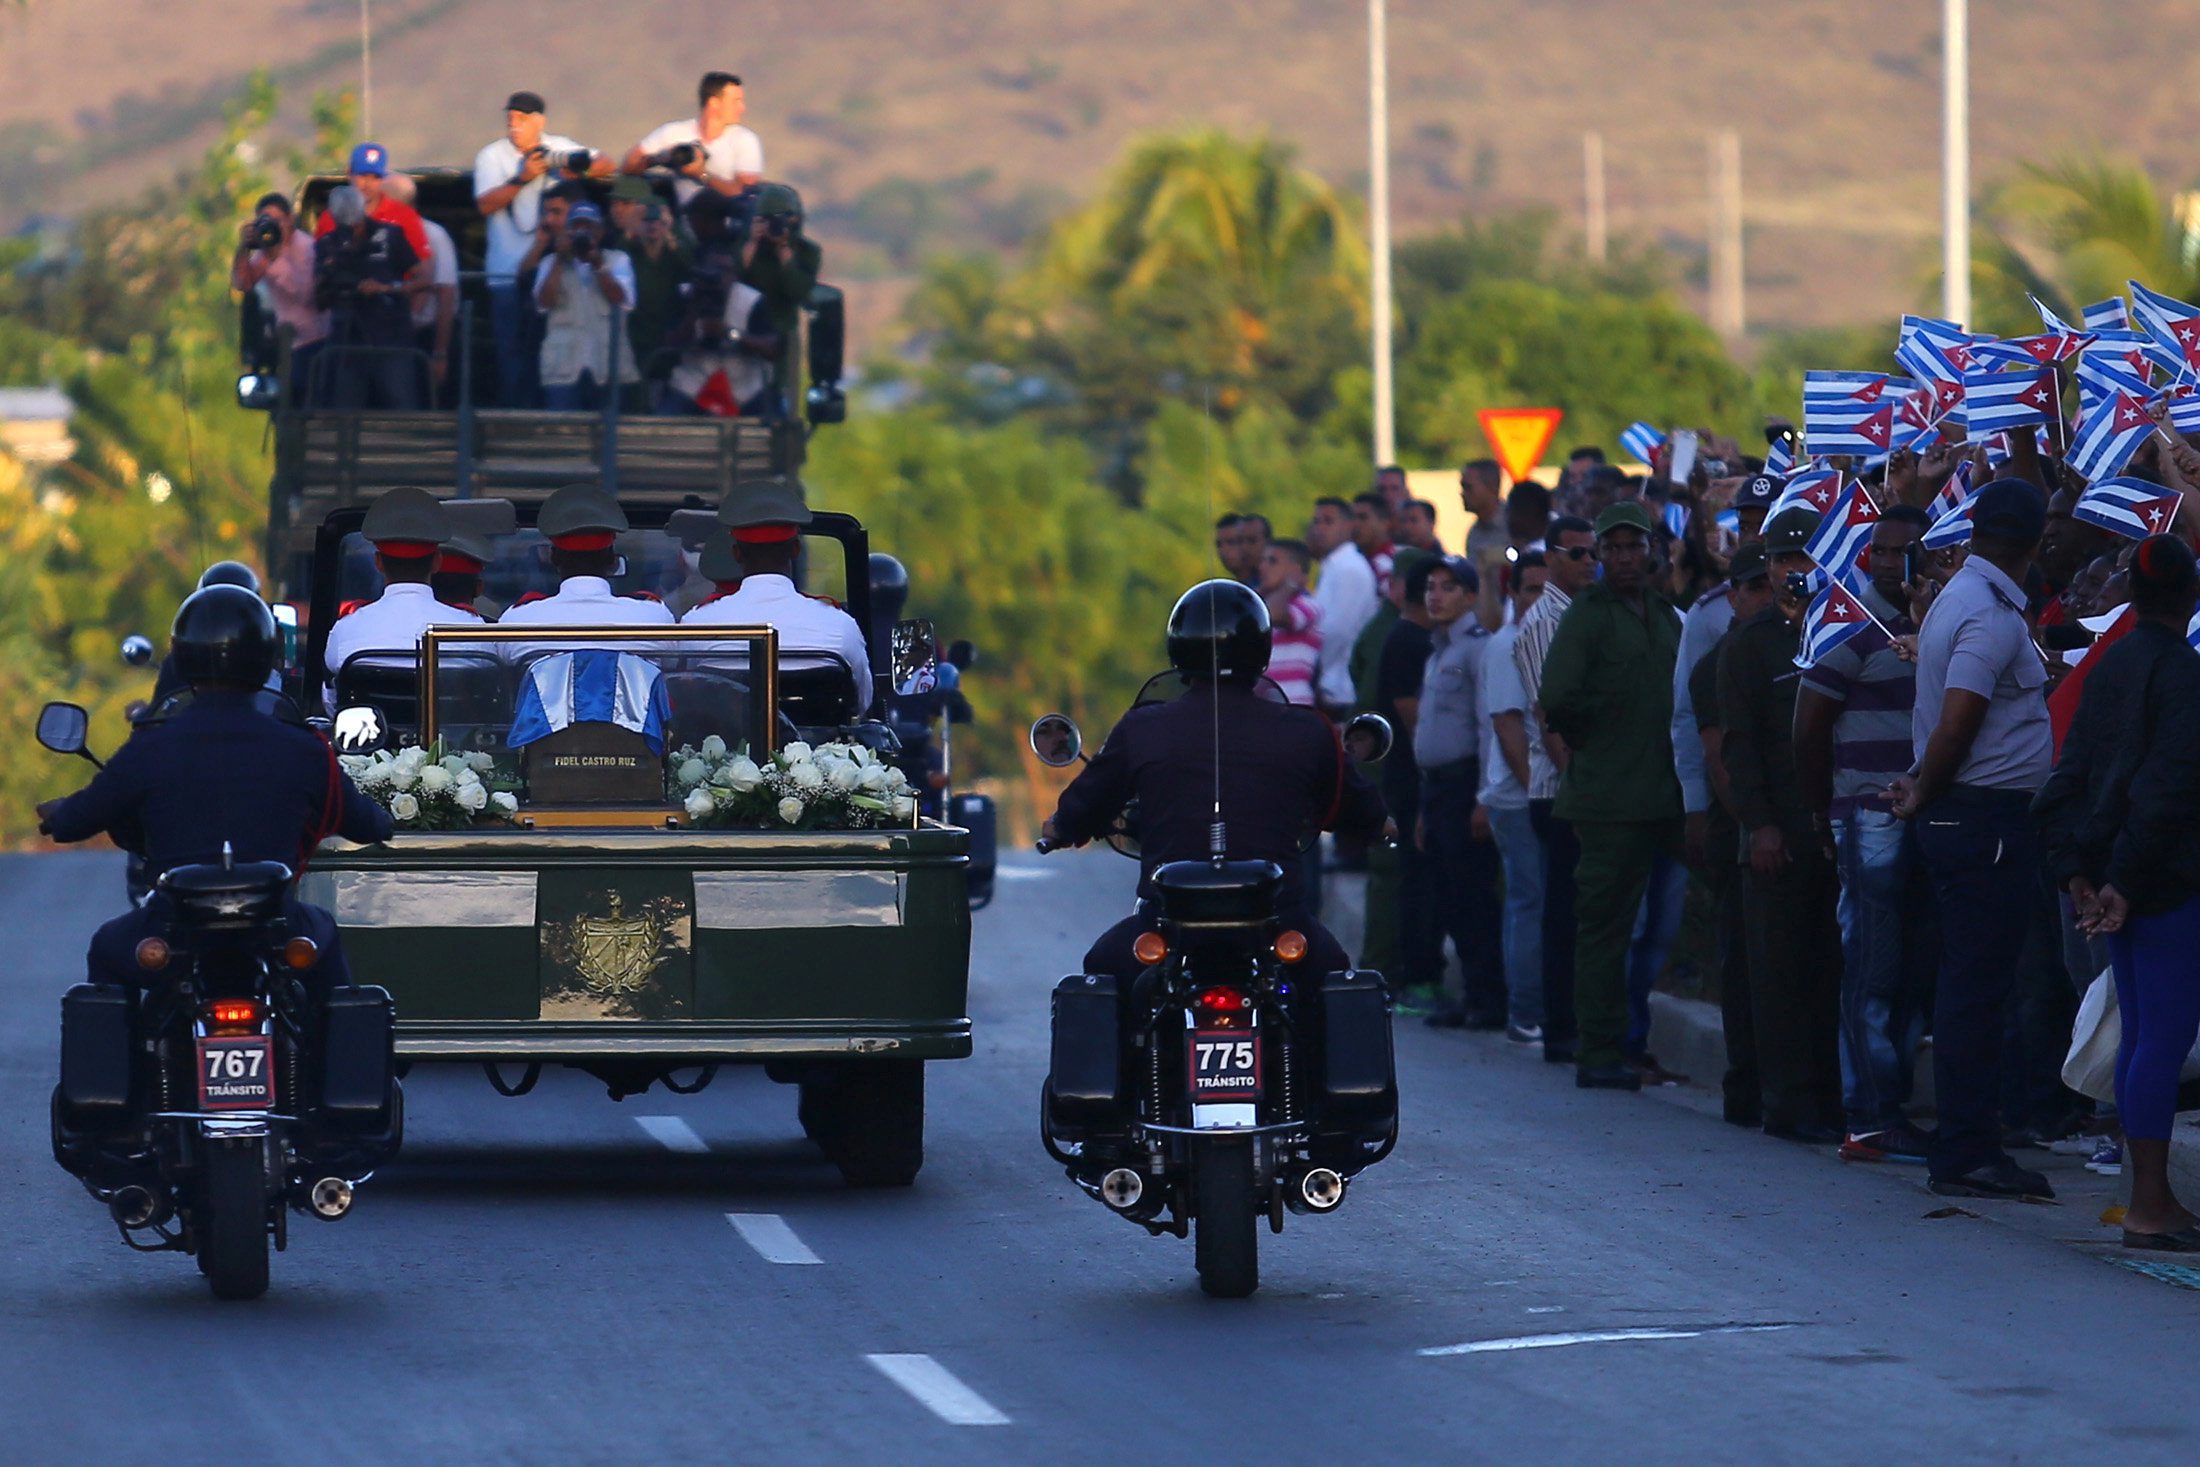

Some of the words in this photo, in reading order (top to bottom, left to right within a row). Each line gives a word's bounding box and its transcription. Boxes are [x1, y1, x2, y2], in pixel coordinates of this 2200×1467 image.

[555, 756, 580, 767] FIDEL
[582, 756, 616, 767] CASTRO
[618, 756, 636, 767] RUZ
[1196, 1041, 1254, 1070] 775
[205, 1050, 265, 1078] 767
[1197, 1074, 1255, 1088] TRÁNSITO
[206, 1082, 266, 1096] TRÁNSITO
